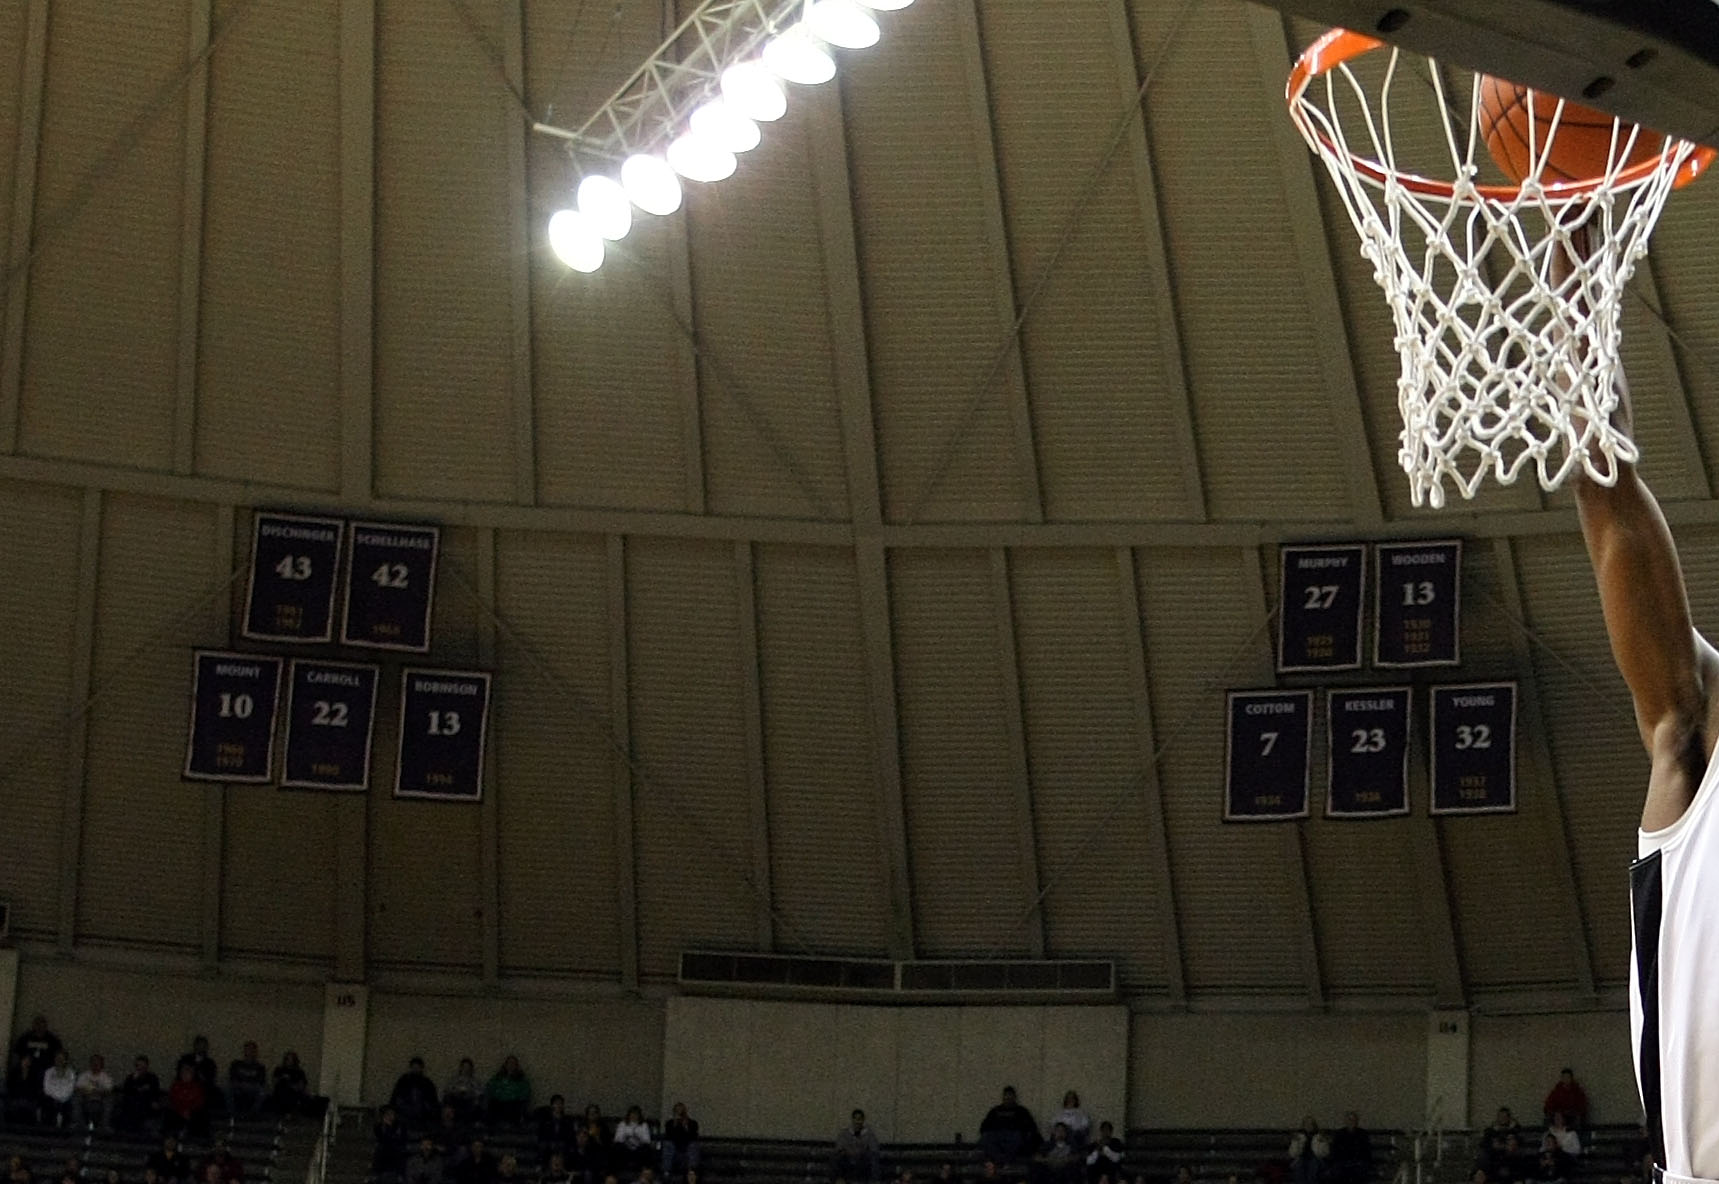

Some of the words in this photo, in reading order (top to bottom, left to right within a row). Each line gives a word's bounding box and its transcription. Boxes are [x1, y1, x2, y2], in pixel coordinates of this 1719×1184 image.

[275, 554, 312, 580] 43
[1298, 557, 1349, 569] MURPHY
[1392, 553, 1446, 566] WOODEN
[370, 562, 408, 589] 42
[1304, 585, 1340, 610] 27
[1401, 581, 1436, 606] 13
[216, 664, 261, 679] MOUNT
[307, 671, 360, 688] CARROLL
[415, 681, 478, 696] ROBINSON
[217, 692, 254, 719] 10
[1246, 702, 1295, 716] COTTOM
[1344, 699, 1395, 712] KESSLER
[1452, 695, 1495, 708] YOUNG
[311, 701, 348, 728] 22
[426, 710, 461, 736] 13
[1260, 732, 1278, 756] 7
[1350, 728, 1386, 753] 23
[1455, 725, 1491, 749] 32
